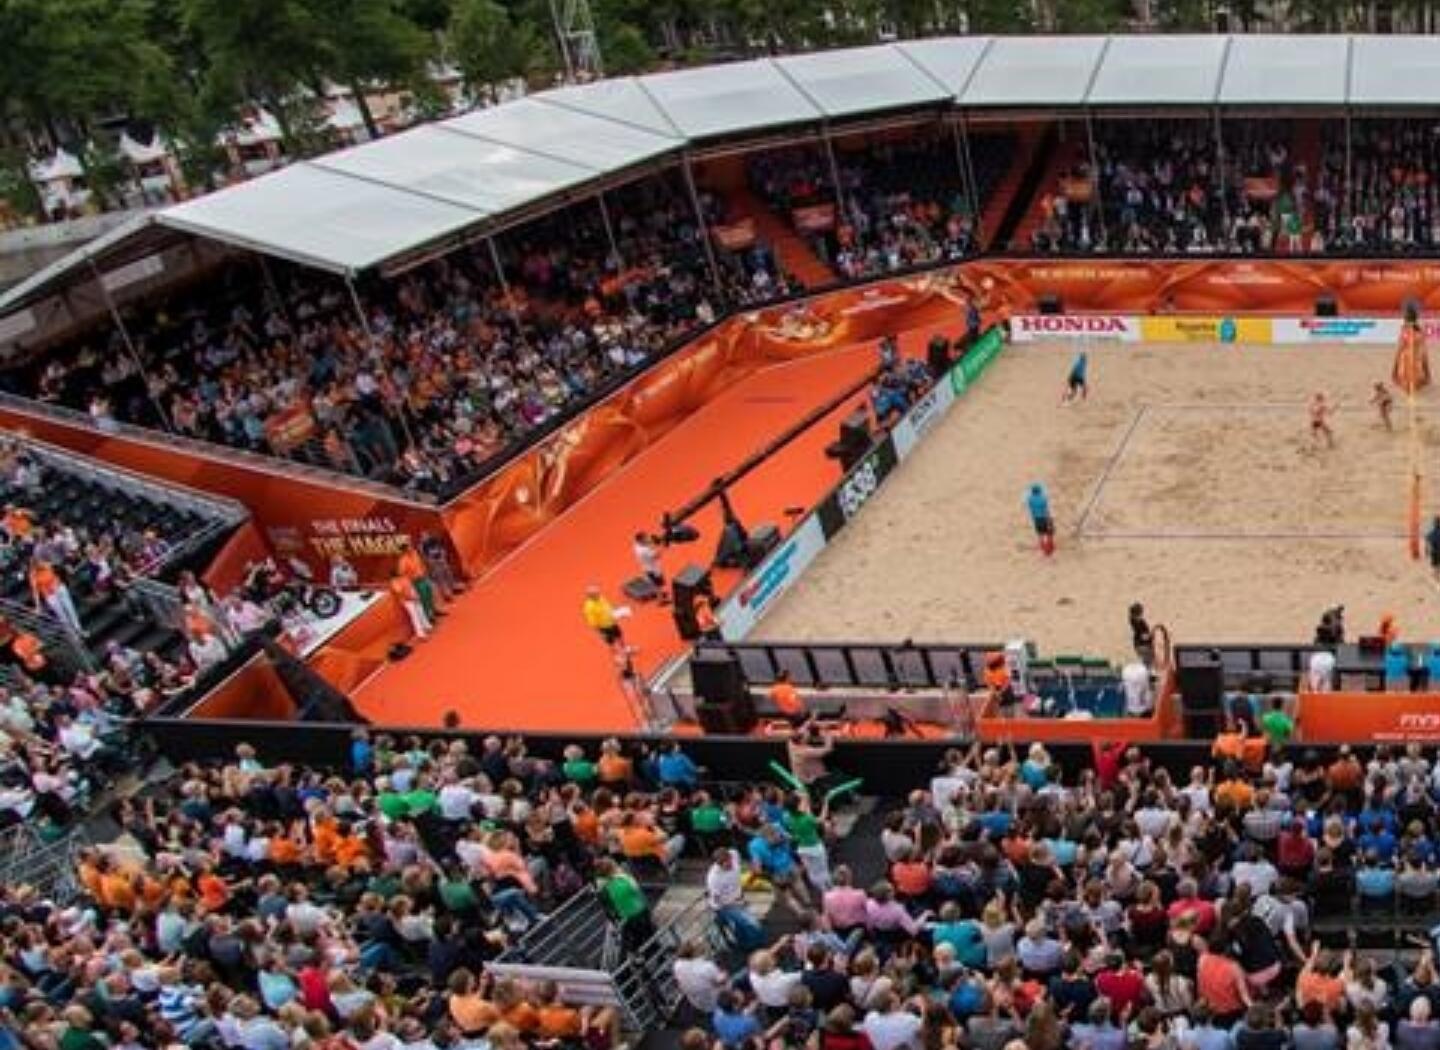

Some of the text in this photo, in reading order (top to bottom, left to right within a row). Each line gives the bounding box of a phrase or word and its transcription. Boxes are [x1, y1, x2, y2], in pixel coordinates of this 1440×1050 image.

[1022, 318, 1127, 332] HONDA
[311, 517, 397, 534] THE FINALS
[310, 536, 350, 558] THE
[348, 533, 410, 556] HAGUE
